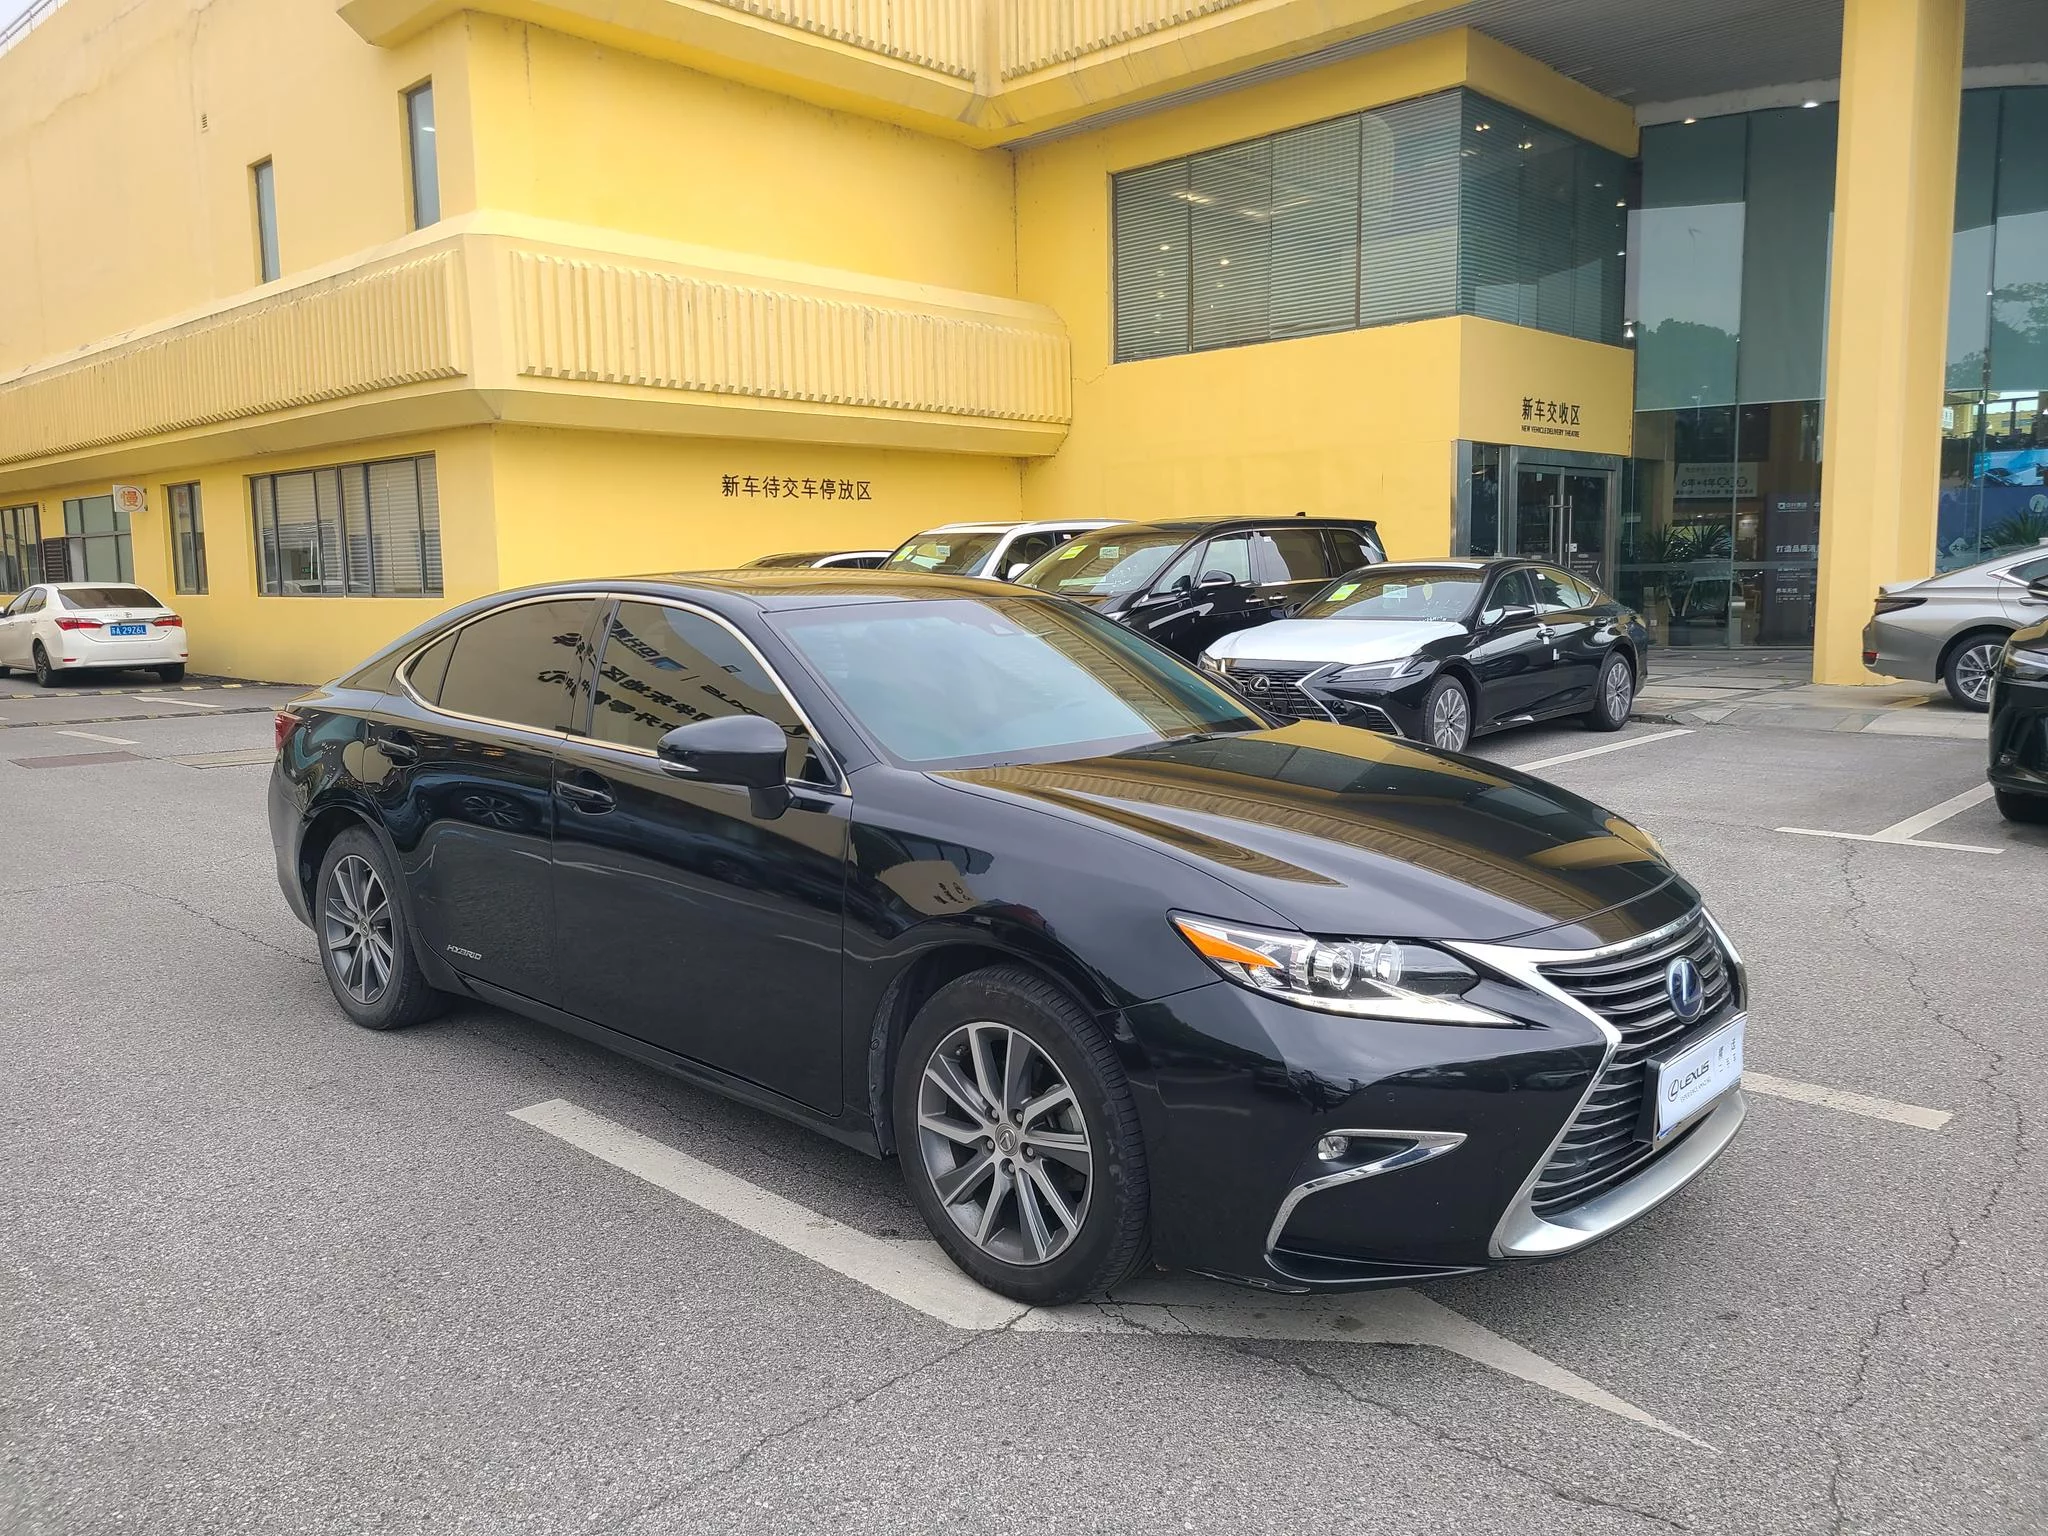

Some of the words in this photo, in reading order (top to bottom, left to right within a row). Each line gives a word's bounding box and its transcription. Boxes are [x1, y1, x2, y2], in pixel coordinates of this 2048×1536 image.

[1521, 397, 1580, 425] 新车交收区
[721, 474, 872, 501] 新车待交车停放区
[446, 944, 482, 961] HYBRID
[1679, 1060, 1710, 1090] LEXUS
